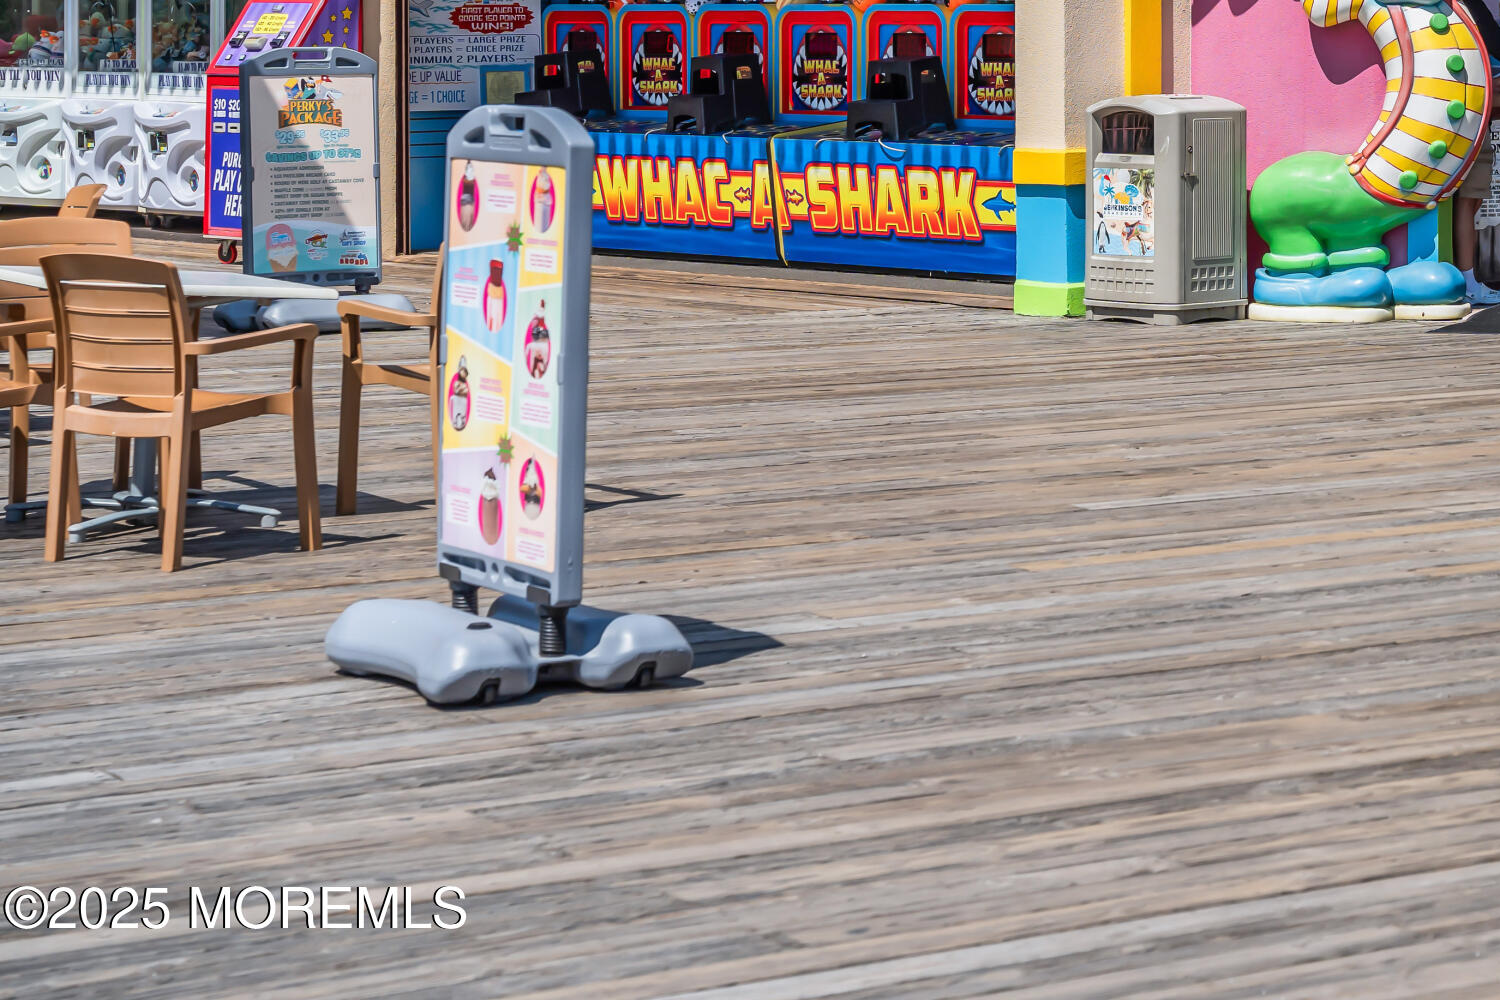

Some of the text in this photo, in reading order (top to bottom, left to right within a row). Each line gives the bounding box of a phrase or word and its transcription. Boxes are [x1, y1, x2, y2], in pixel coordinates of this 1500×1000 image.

[413, 36, 454, 45] PLAYERS
[468, 36, 497, 44] LARGE
[414, 46, 452, 54] PLAYERS
[500, 44, 525, 52] PRIZE
[410, 54, 516, 64] INIMUM 2 PLAYERS
[642, 57, 676, 71] WHAC
[803, 59, 840, 74] WHAC
[26, 70, 42, 80] YOU
[44, 70, 60, 82] WIN
[420, 71, 432, 82] UP
[435, 70, 462, 82] VALUE
[654, 69, 663, 82] A
[816, 72, 826, 85] A
[640, 80, 678, 94] SHARK
[800, 84, 843, 98] SHARK
[437, 90, 466, 102] CHOICE
[214, 99, 226, 111] $10
[290, 100, 334, 112] PERKY'S
[280, 111, 342, 127] PACKAGE
[323, 150, 336, 159] TO
[213, 170, 236, 191] PLAY
[595, 154, 734, 227] WHAC
[804, 161, 983, 242] SHARK
